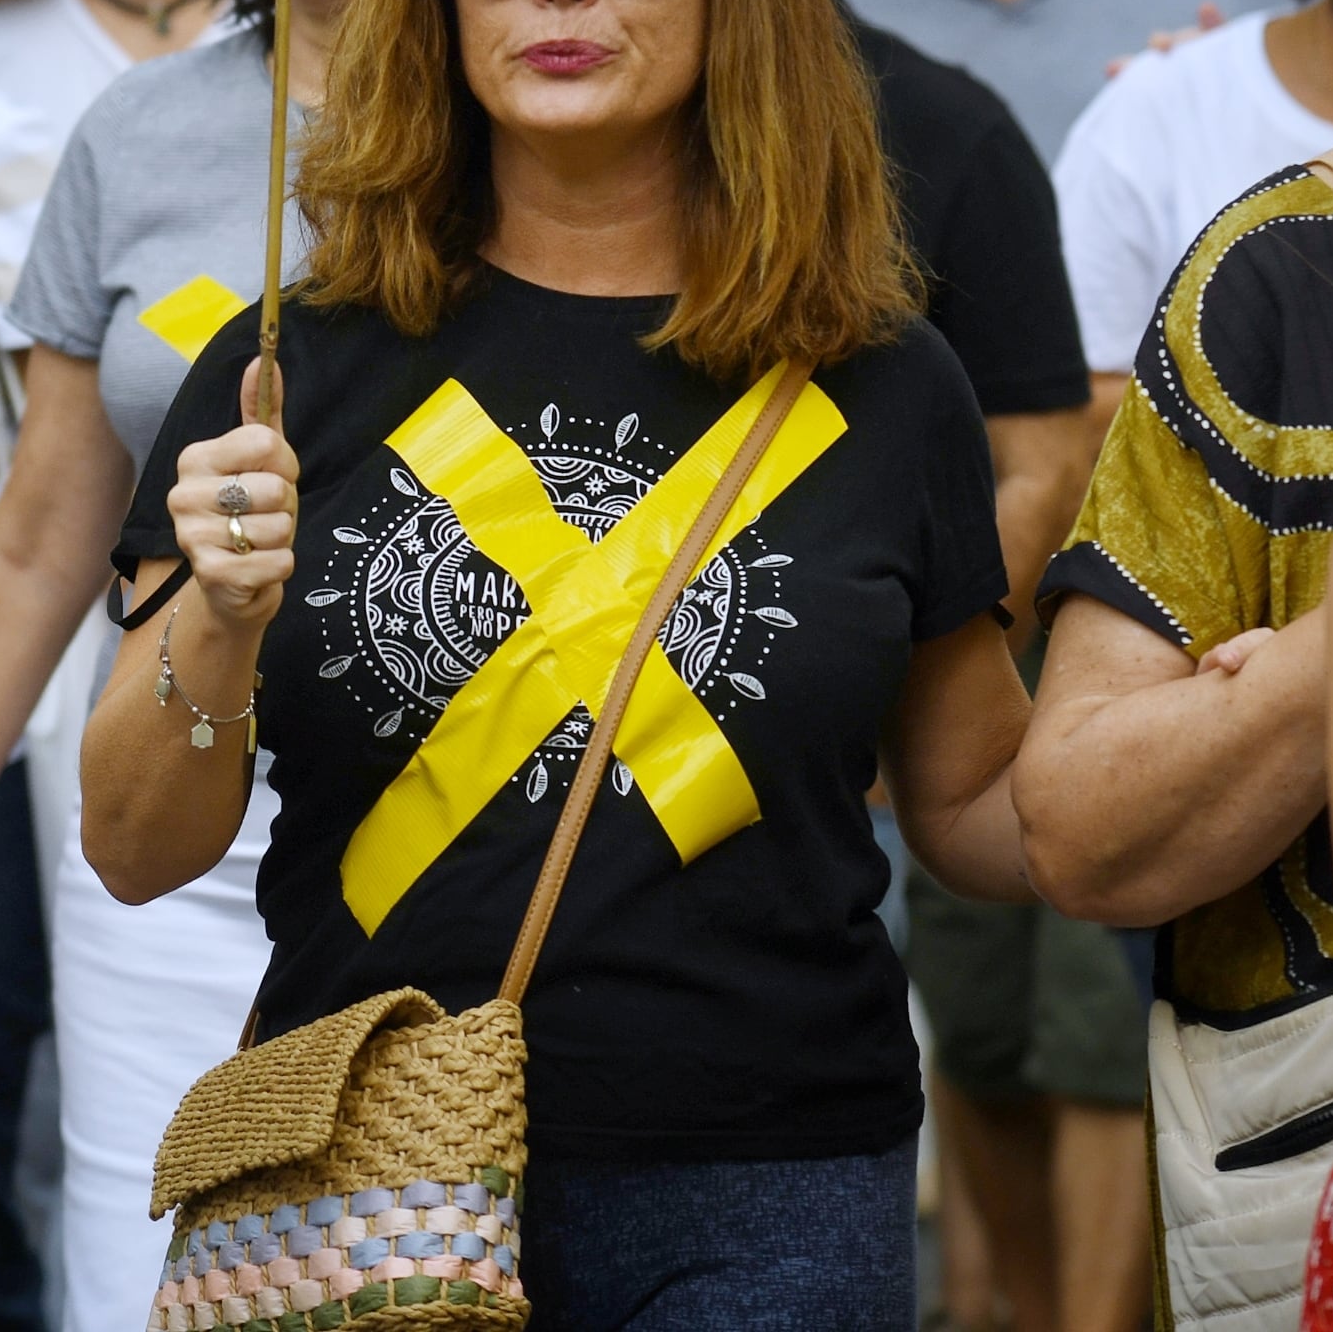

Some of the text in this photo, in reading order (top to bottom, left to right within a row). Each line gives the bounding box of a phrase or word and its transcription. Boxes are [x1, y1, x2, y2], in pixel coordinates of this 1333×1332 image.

[455, 572, 527, 609] MAR
[460, 604, 494, 621] PERO
[471, 618, 493, 638] NO
